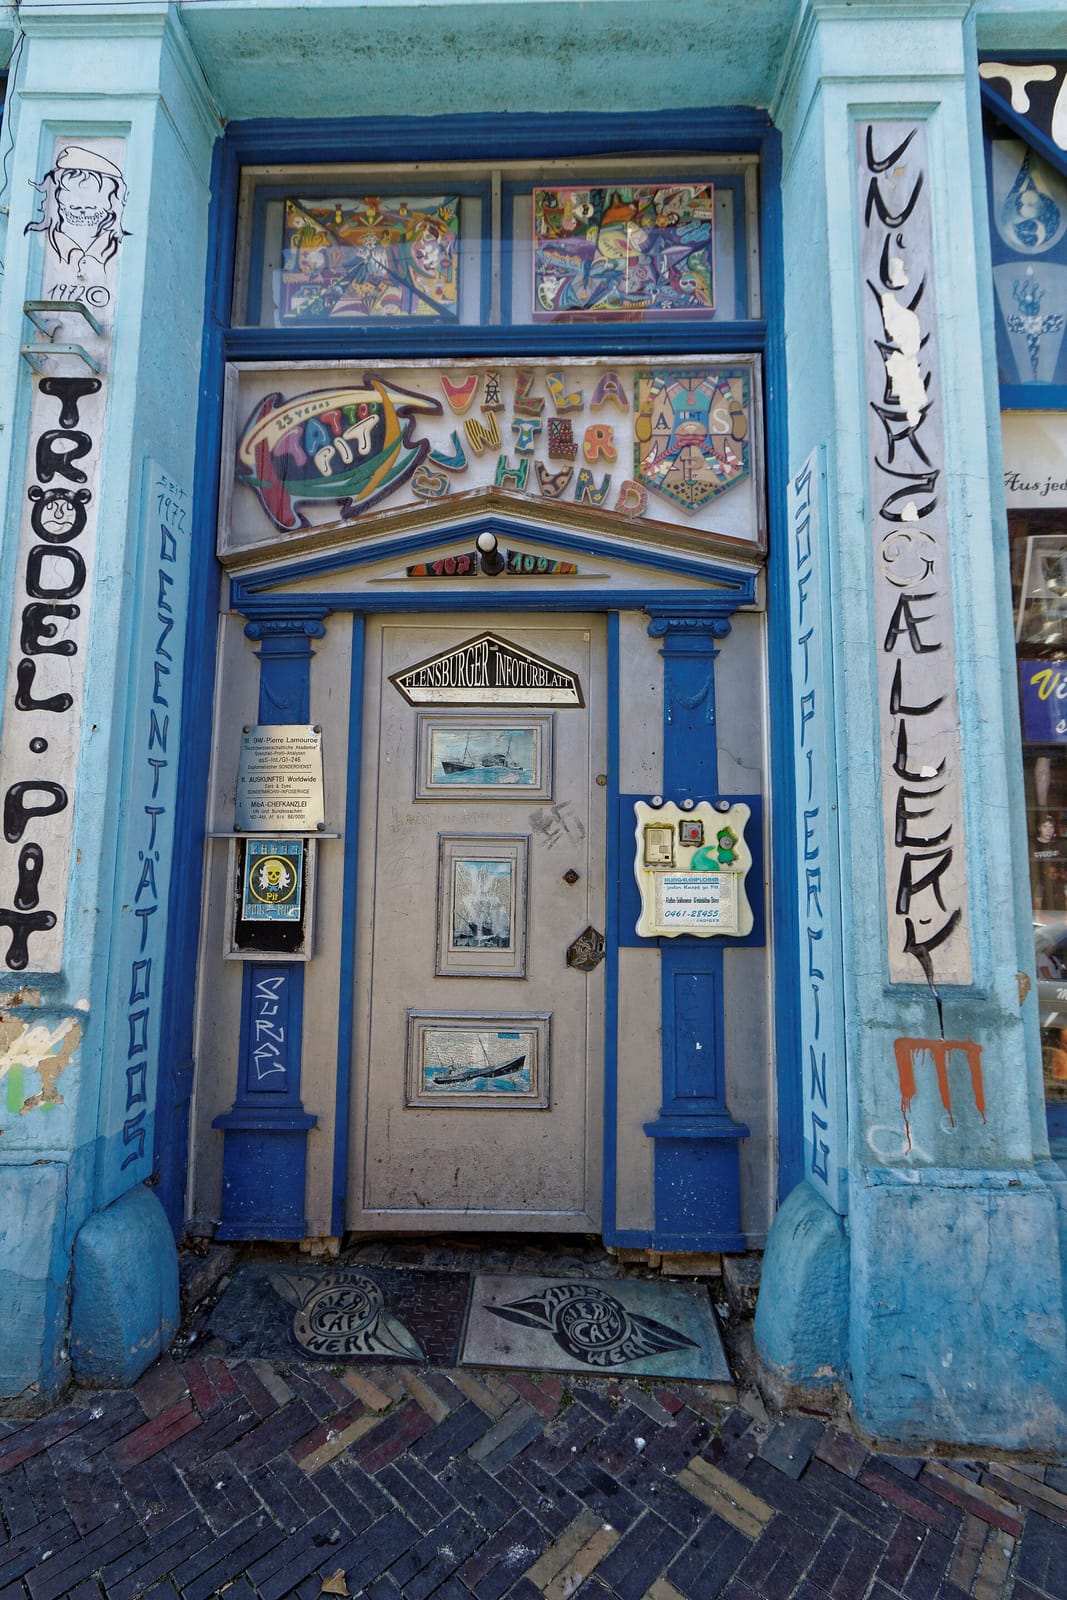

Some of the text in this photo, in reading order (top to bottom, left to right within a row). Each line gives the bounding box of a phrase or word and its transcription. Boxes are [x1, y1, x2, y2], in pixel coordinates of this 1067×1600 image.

[440, 370, 630, 416] VILLA
[275, 400, 332, 431] 25 YEARS
[272, 402, 379, 467] TATTOO
[313, 414, 380, 477] PIT
[1003, 470, 1040, 492] Aus
[157, 493, 186, 535] 1972
[511, 552, 548, 574] 109
[405, 641, 571, 688] FLENSBURGER INFOTÜRBLATT
[287, 775, 317, 783] Worldwide
[0, 780, 68, 971] PIT
[266, 892, 280, 902] Pit
[664, 910, 719, 918] 0461-28455
[317, 1291, 364, 1311] BIER
[564, 1302, 606, 1323] BIER
[306, 1319, 388, 1353] WERK
[587, 1325, 657, 1366] WERK
